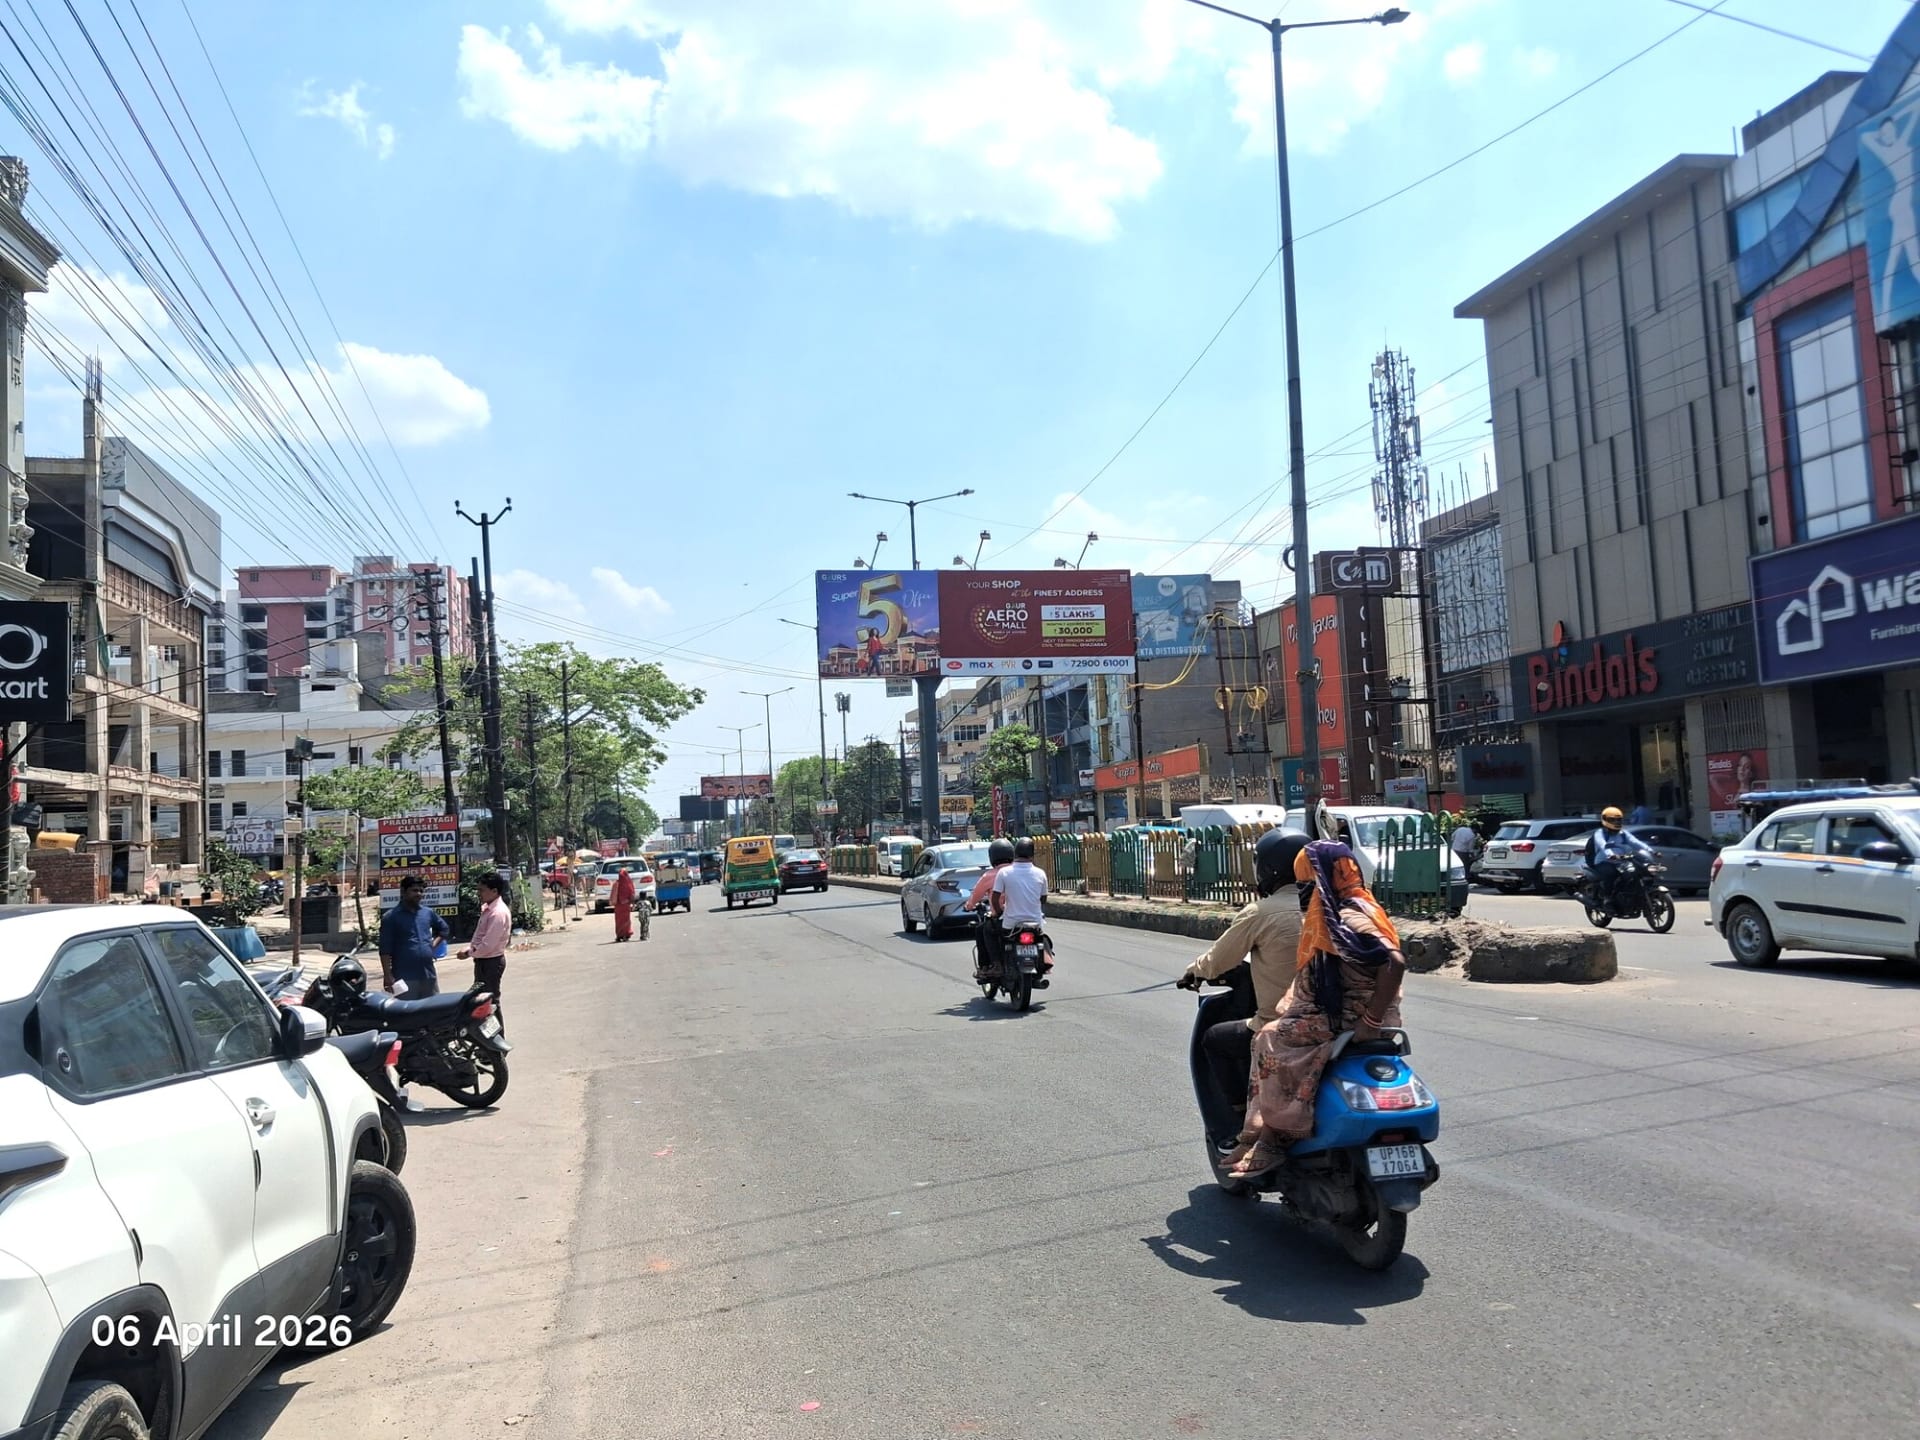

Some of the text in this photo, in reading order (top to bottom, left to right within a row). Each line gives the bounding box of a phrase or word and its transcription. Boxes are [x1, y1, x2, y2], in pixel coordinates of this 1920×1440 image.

[991, 580, 1021, 588] SHOP
[831, 590, 859, 603] Super
[986, 609, 1029, 622] AERO
[1002, 621, 1027, 630] MALL
[1071, 660, 1100, 668] 72900
[1527, 633, 1658, 712] Bindals
[420, 832, 454, 842] CMA
[382, 868, 418, 877] Economics
[1380, 1146, 1416, 1160] UP16B
[1382, 1160, 1418, 1174] X7064
